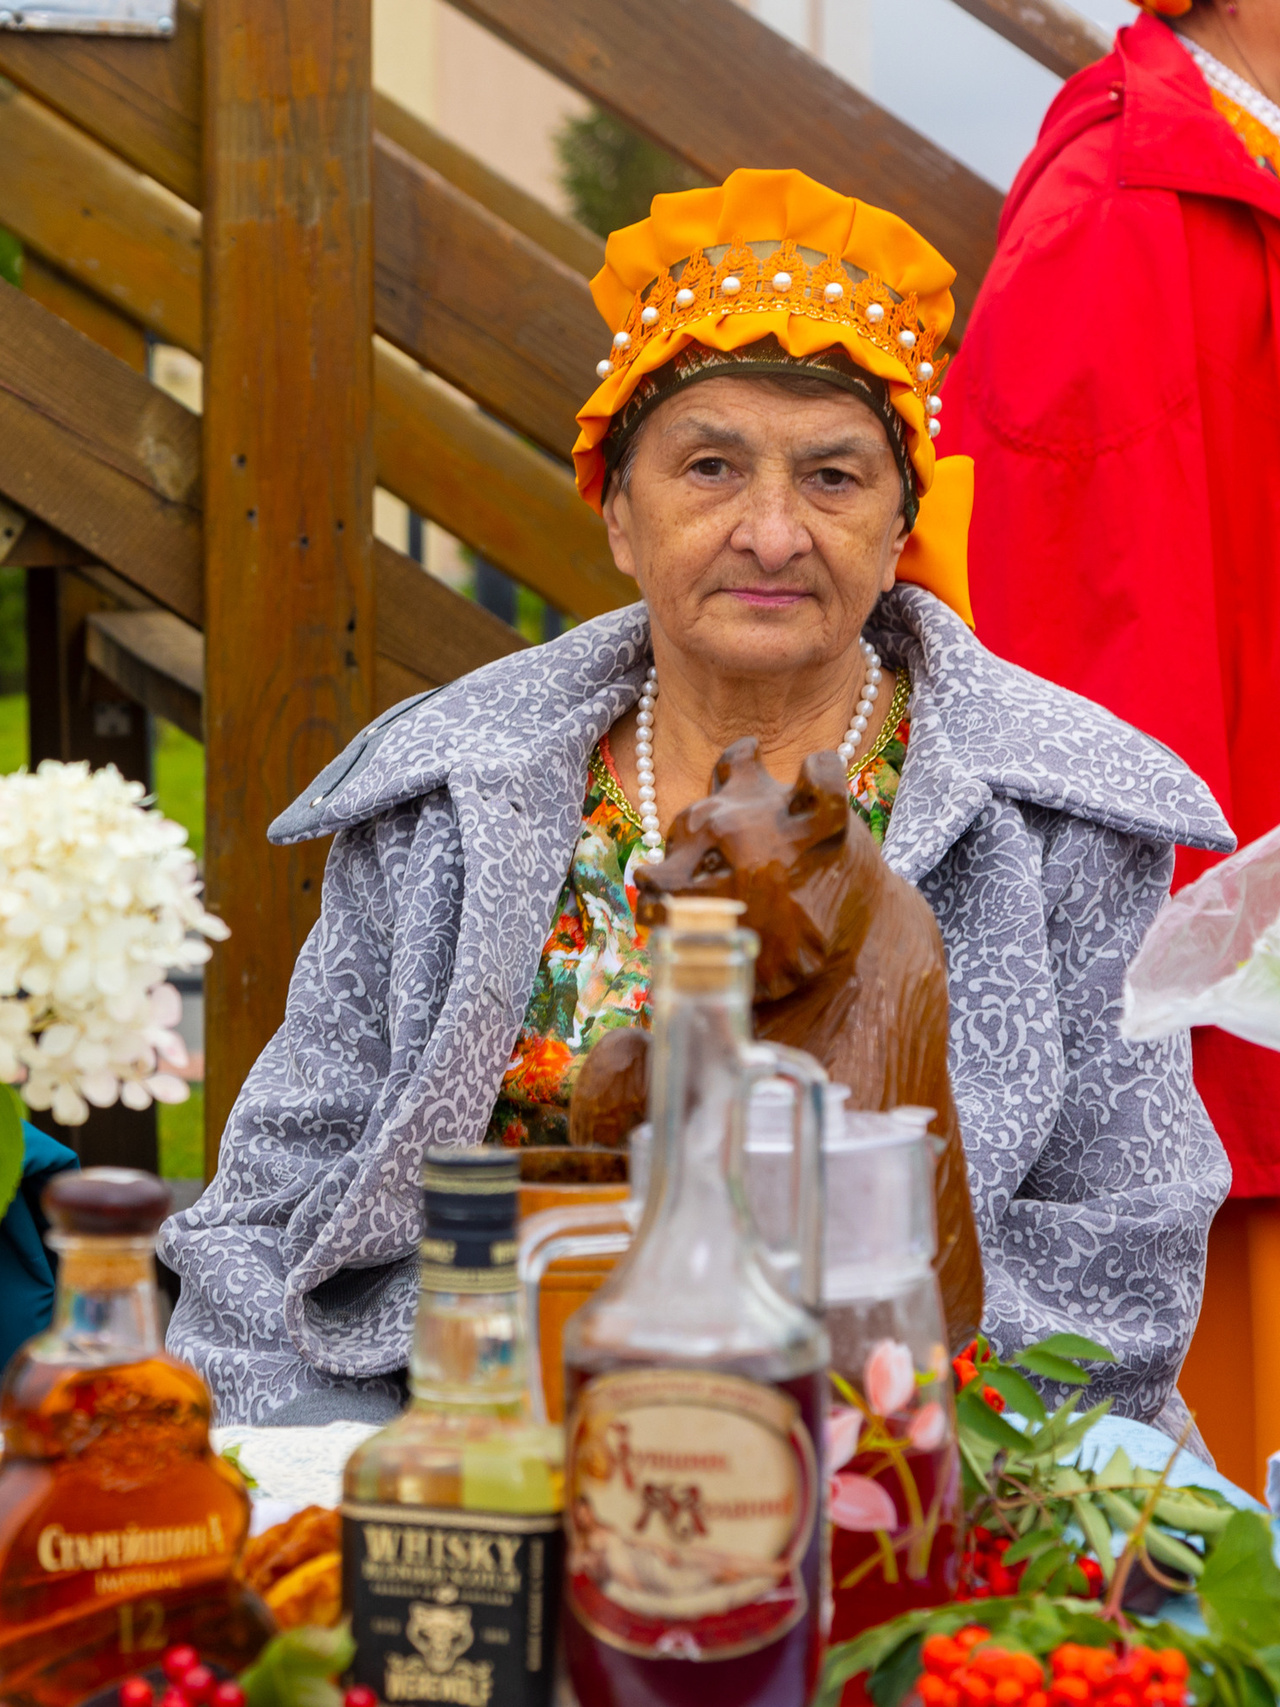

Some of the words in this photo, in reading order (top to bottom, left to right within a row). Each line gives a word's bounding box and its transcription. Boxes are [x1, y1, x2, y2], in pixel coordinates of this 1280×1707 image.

[37, 1513, 224, 1573] СТАРЕЙШИНА
[363, 1523, 522, 1574] WHISKY
[119, 1600, 169, 1653] 12
